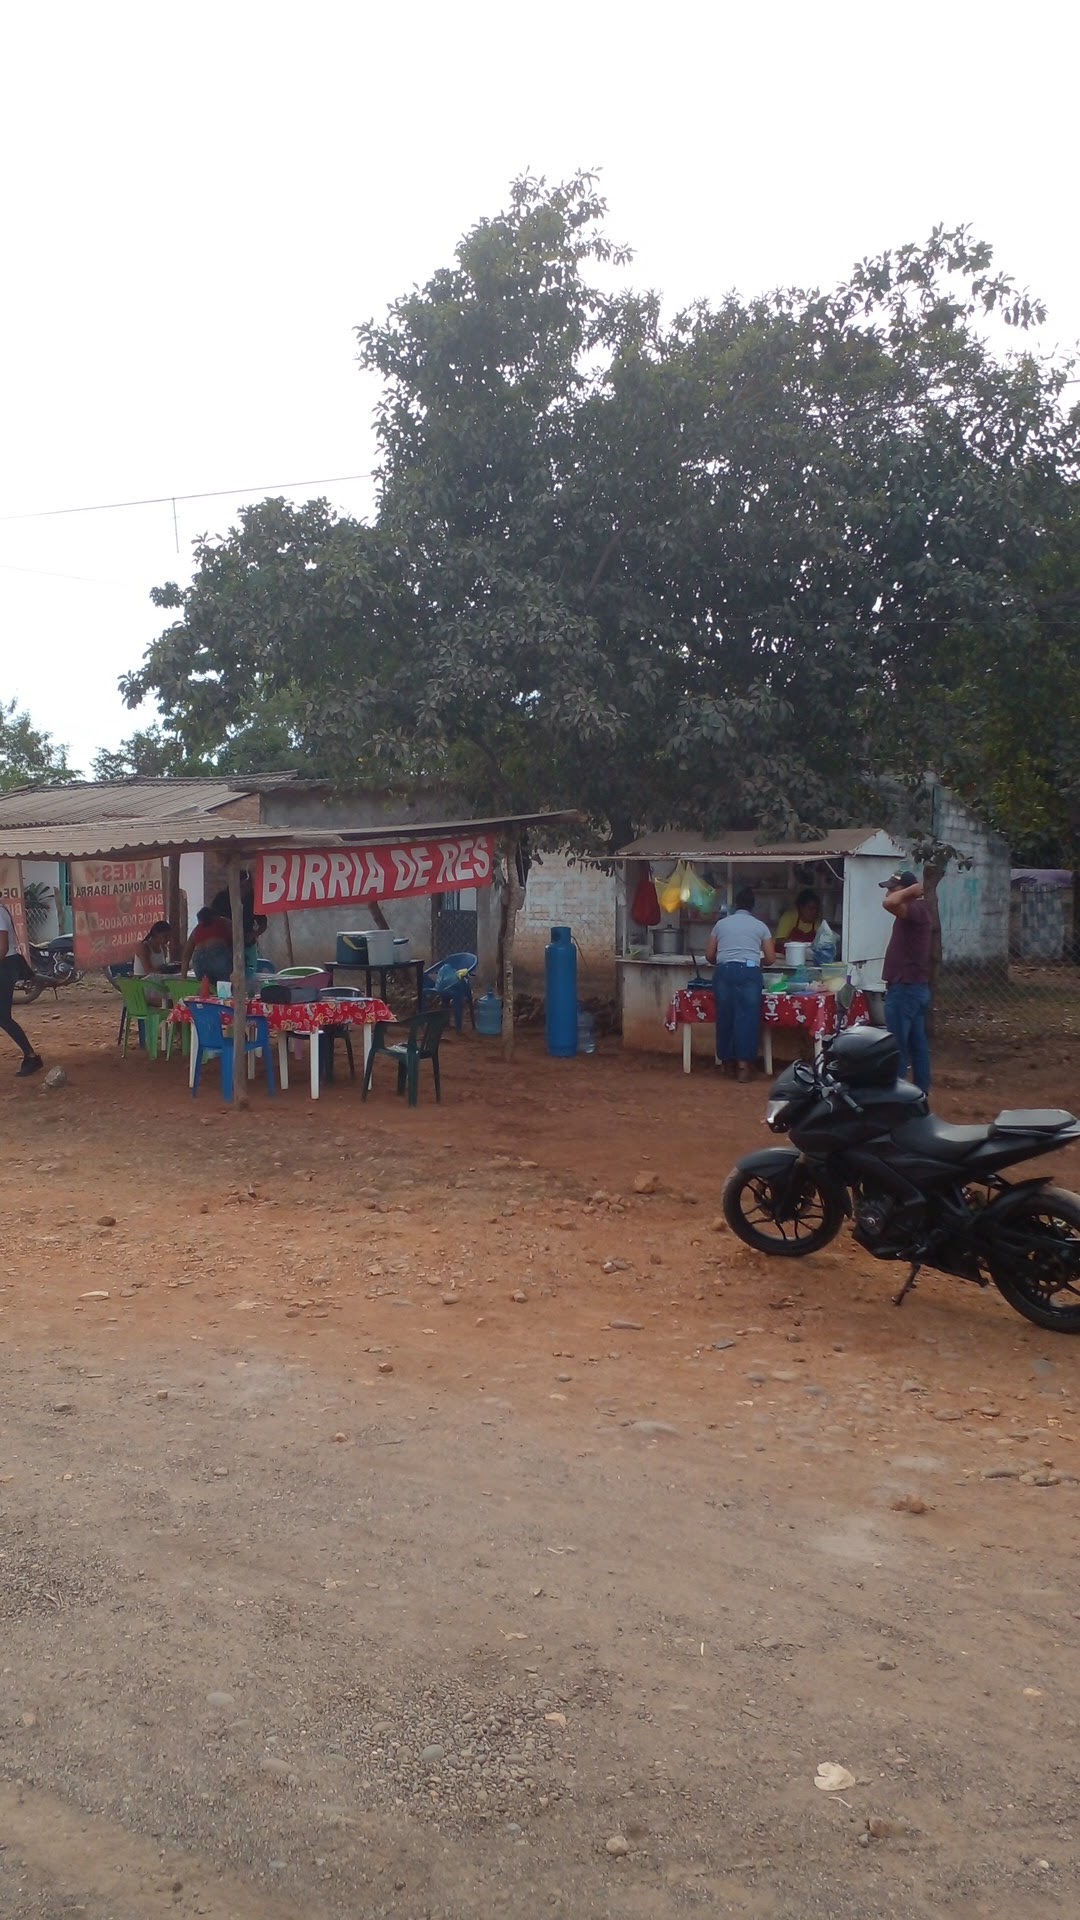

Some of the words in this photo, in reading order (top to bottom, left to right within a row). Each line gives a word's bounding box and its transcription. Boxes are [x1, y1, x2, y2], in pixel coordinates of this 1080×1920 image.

[263, 852, 384, 904] BIRRIA
[391, 847, 433, 891] DE
[437, 837, 490, 883] RES
